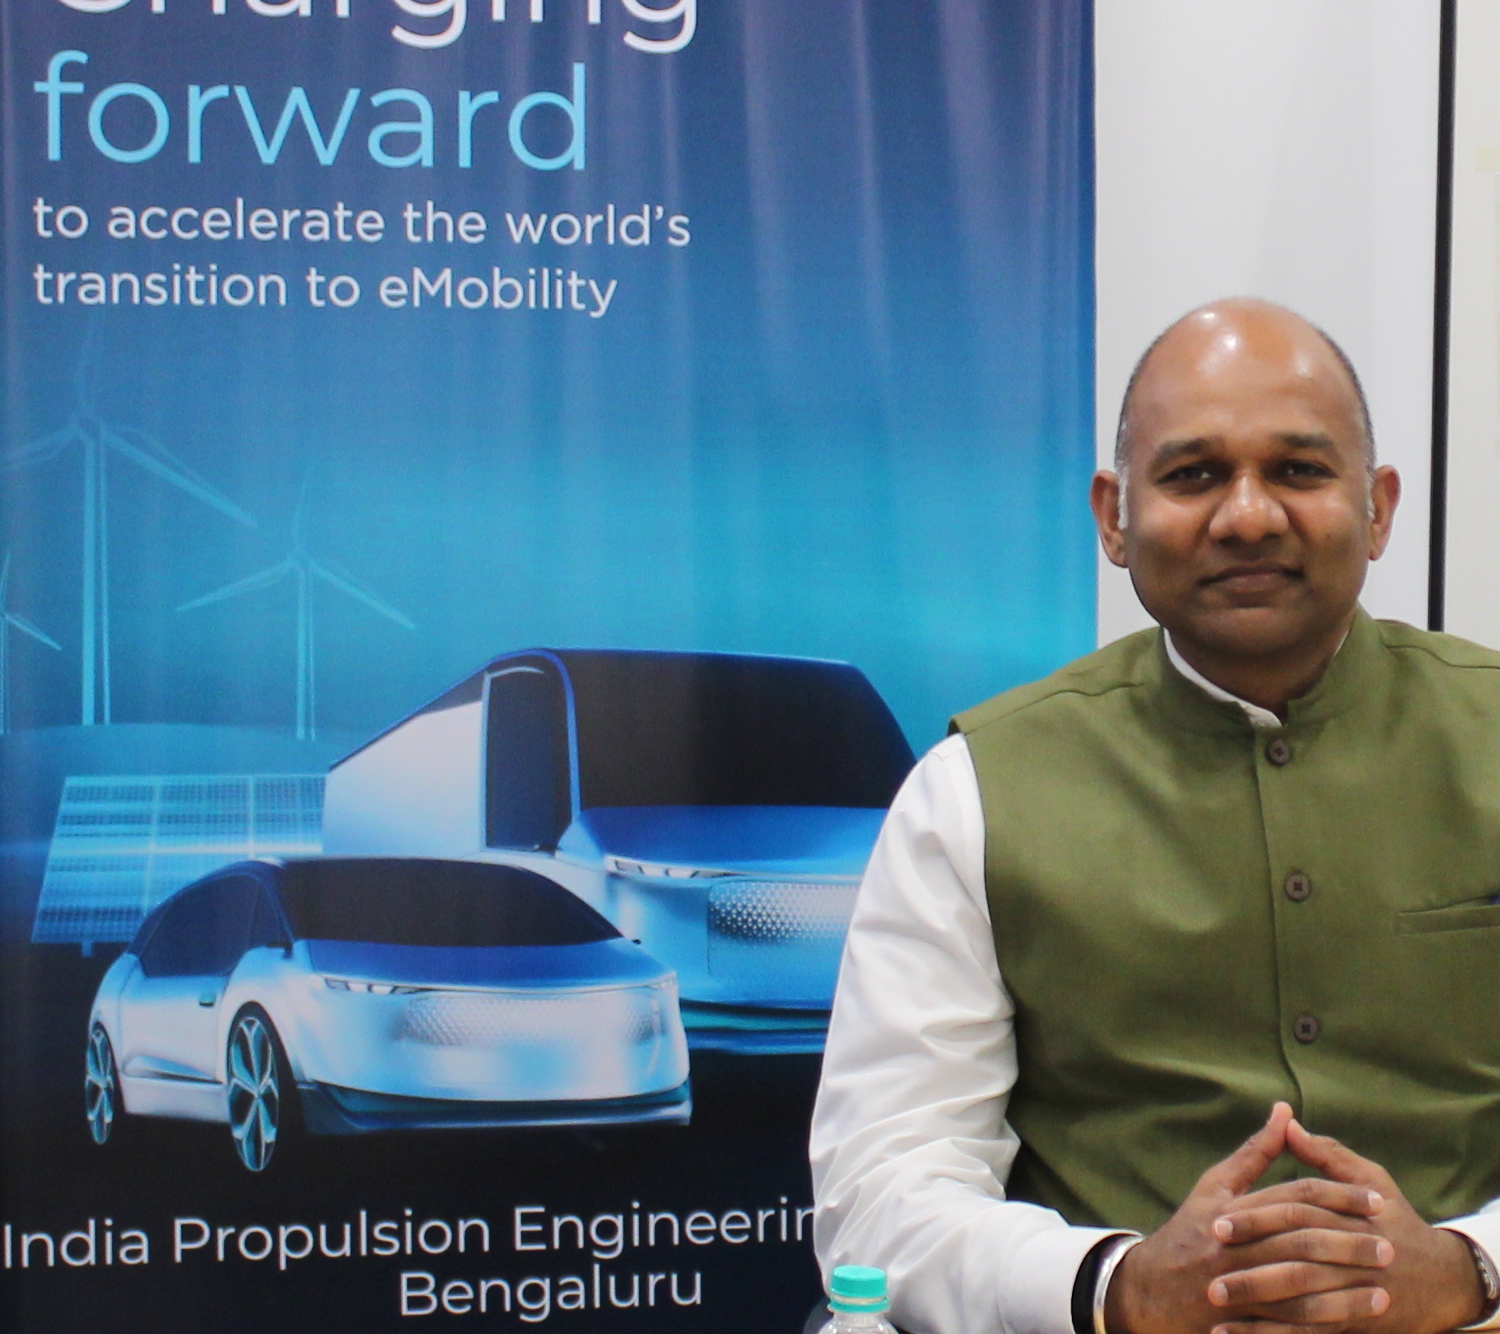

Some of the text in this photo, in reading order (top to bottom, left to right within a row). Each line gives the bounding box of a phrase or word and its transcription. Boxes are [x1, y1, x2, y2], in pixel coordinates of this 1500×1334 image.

[33, 51, 588, 171] forward
[32, 197, 690, 246] to accelerate the world’s
[33, 263, 617, 318] transition to eMobility
[4, 1218, 149, 1269] India
[174, 1209, 490, 1273] Propulsion
[400, 1261, 702, 1323] Bengaluru
